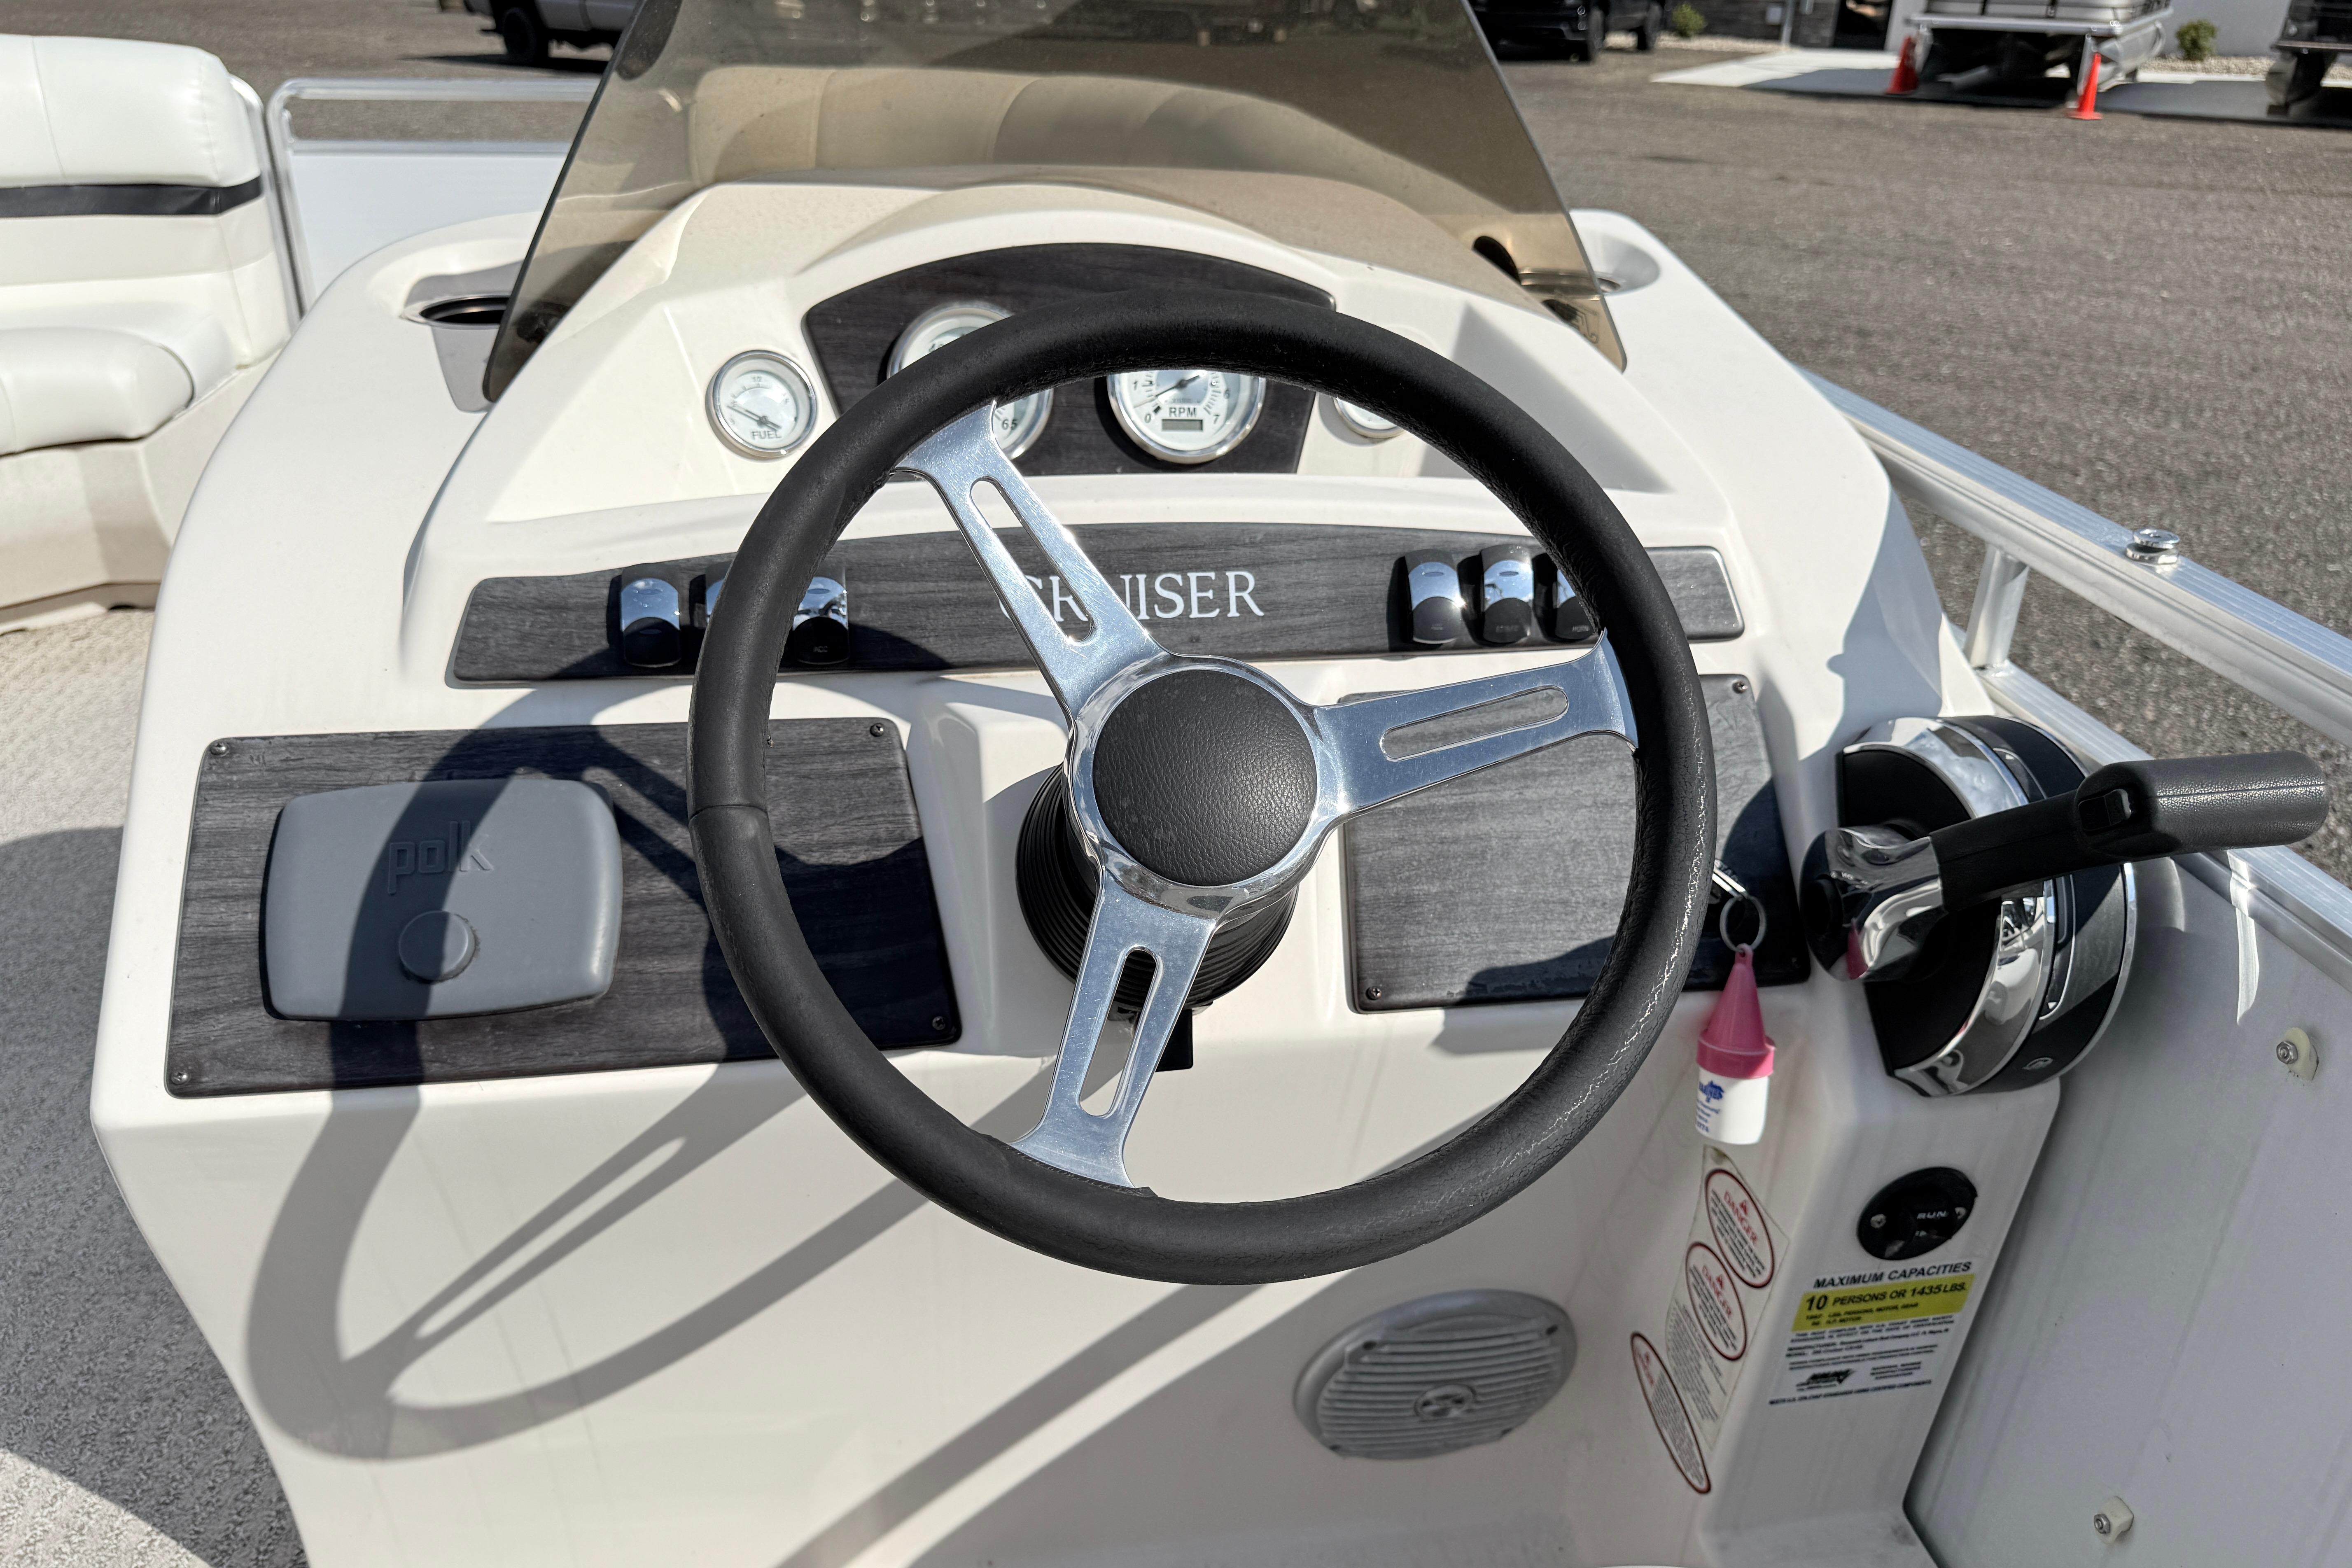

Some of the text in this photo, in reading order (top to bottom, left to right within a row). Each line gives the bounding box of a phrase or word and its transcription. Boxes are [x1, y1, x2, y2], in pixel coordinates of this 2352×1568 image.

[1144, 413, 1151, 423] 0
[1169, 407, 1197, 418] RPM
[1001, 419, 1018, 430] 65
[1213, 414, 1220, 425] 7
[751, 430, 782, 440] FUEL
[387, 820, 494, 895] polk
[1724, 1190, 1757, 1244] DANGER
[1917, 1210, 1948, 1219] RUN
[1813, 1261, 1972, 1288] MAXIMUM CAPACITIES
[1806, 1294, 1828, 1311] 10
[1832, 1291, 1888, 1306] PERSONS
[1889, 1289, 1906, 1299] OR
[1911, 1284, 1942, 1297] 1435
